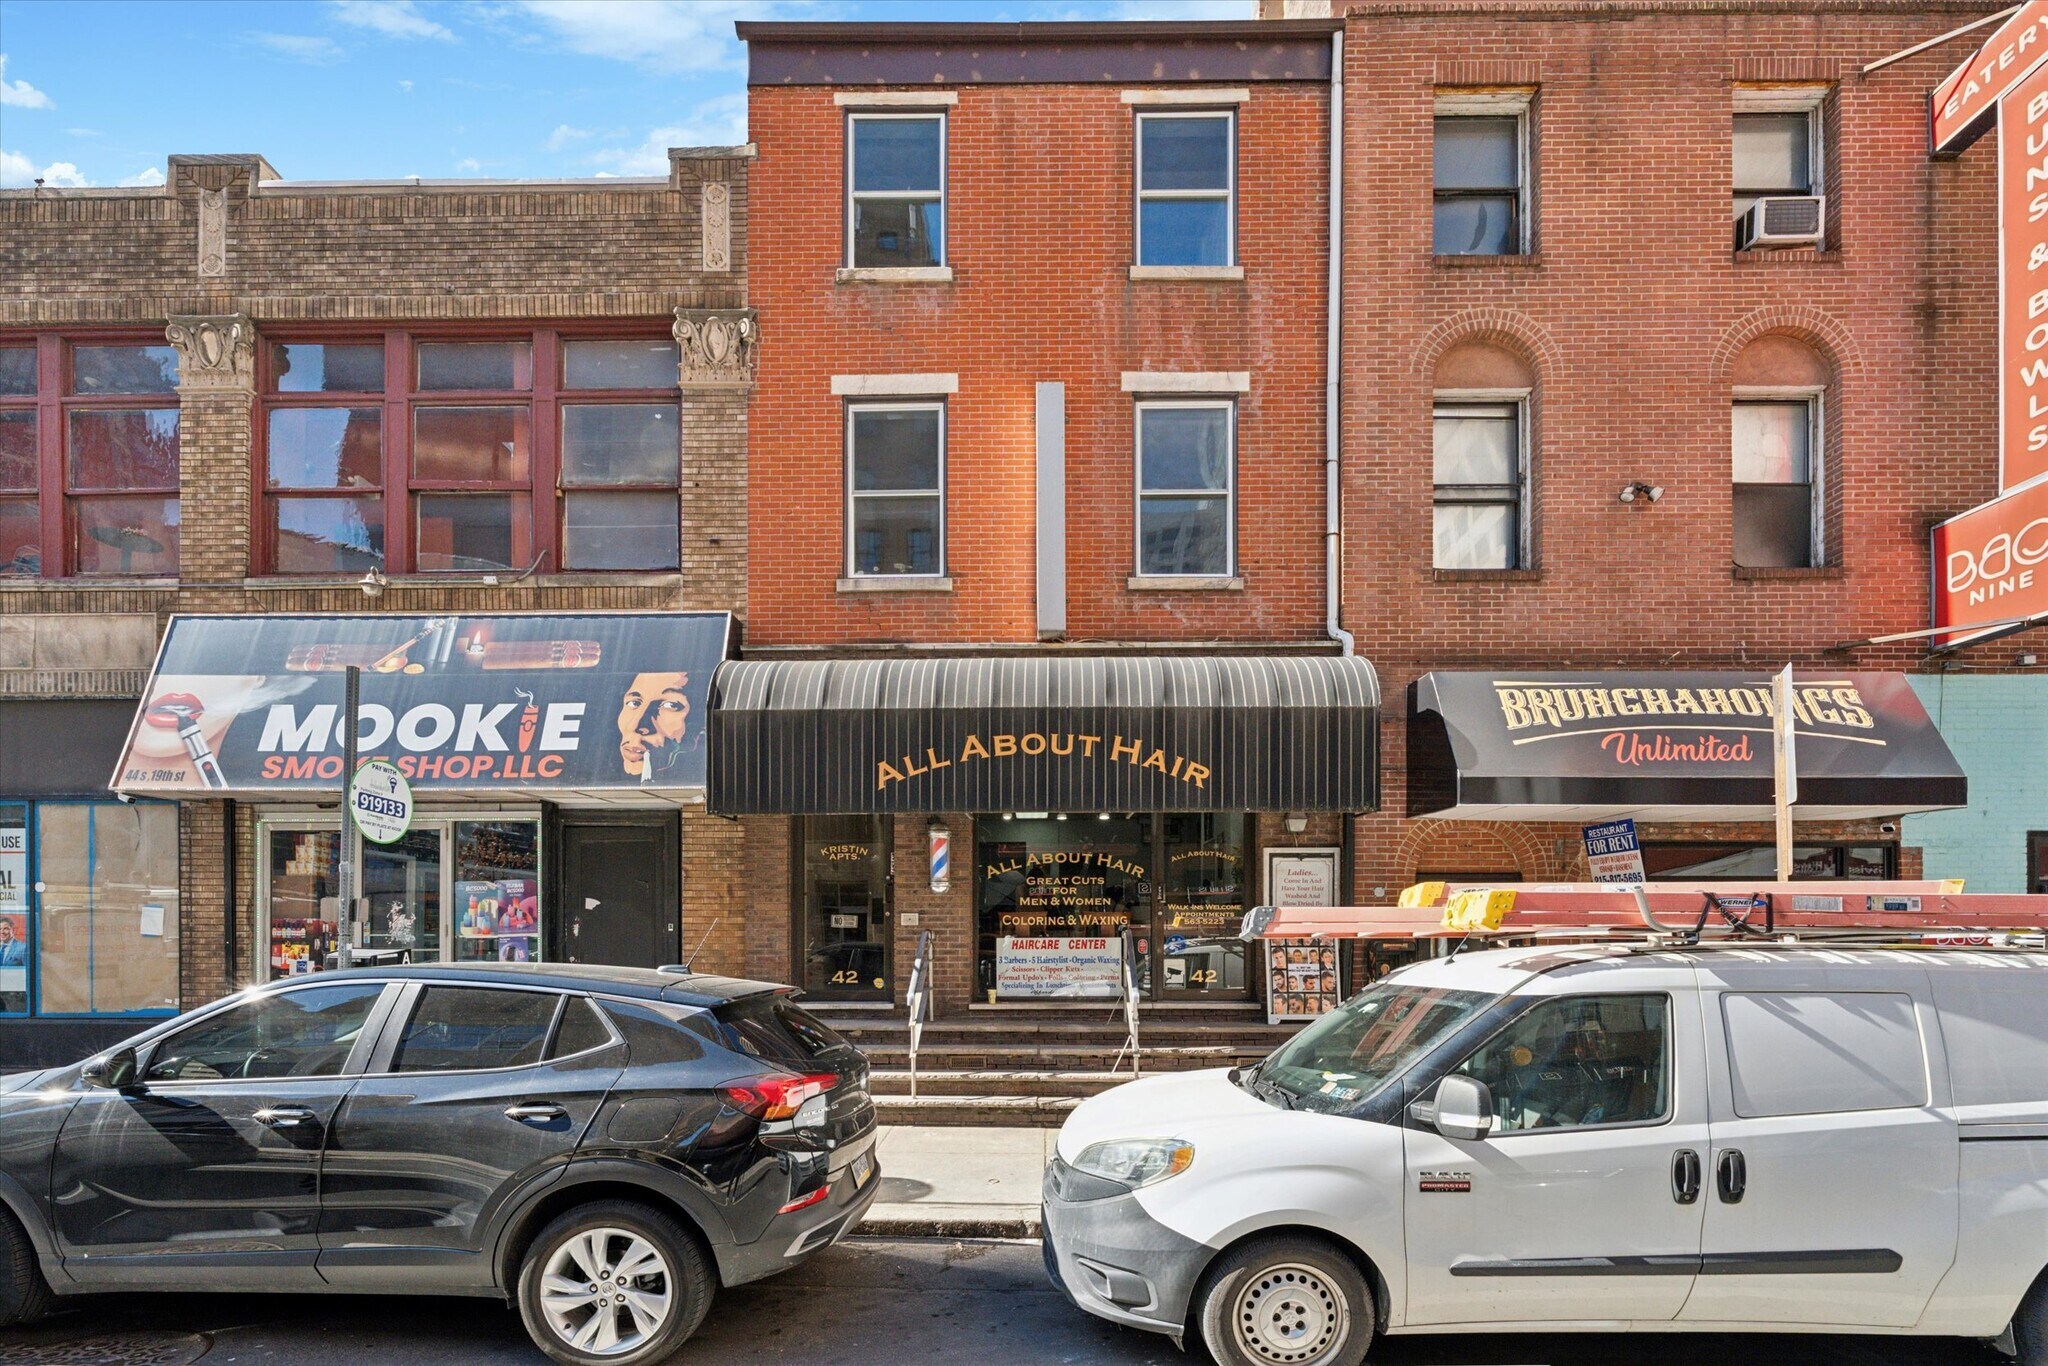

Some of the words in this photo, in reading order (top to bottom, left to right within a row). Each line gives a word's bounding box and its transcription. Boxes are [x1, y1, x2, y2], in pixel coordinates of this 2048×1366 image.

[1969, 570, 2034, 606] NINE
[1601, 732, 1753, 766] Unlimited
[261, 754, 391, 779] SMO
[877, 748, 951, 790] ALL
[959, 733, 1100, 762] ABOUT
[1110, 735, 1211, 789] HAIR
[372, 763, 381, 771] PAY
[383, 767, 397, 775] WITH
[125, 770, 138, 781] 44
[174, 770, 186, 781] st
[360, 794, 403, 817] 919133
[1588, 824, 1628, 838] RESTAURANT
[2, 836, 21, 848] USE
[1587, 839, 1607, 855] FOR
[1608, 835, 1634, 852] RENT
[820, 845, 868, 856] KRISTIN
[1171, 853, 1187, 863] ALL
[1215, 851, 1236, 862] HAIR
[987, 858, 1022, 880] ALL
[1026, 852, 1093, 866] ABOUT
[1097, 853, 1145, 878] HAIR
[1026, 876, 1069, 885] GREAT
[1071, 876, 1105, 885] CUTS
[1052, 887, 1077, 895] FOR
[1019, 897, 1048, 906] MEN
[1050, 897, 1060, 905] &
[1063, 897, 1111, 906] WOMEN
[1002, 915, 1065, 926] COLORING
[1067, 915, 1077, 926] &
[1078, 914, 1128, 926] WAXING
[1011, 939, 1060, 950] HAIRCARE
[1068, 939, 1107, 950] CENTER
[1004, 956, 1028, 964] Barbers
[1037, 956, 1069, 965] Hairstylist
[1072, 956, 1096, 966] Organic
[1097, 956, 1121, 966] Waxing
[1040, 966, 1063, 974] Clipper
[1191, 969, 1218, 983] 42
[831, 970, 859, 984] 42
[1022, 974, 1044, 982] Updo's
[1001, 982, 1035, 990] Specializing
